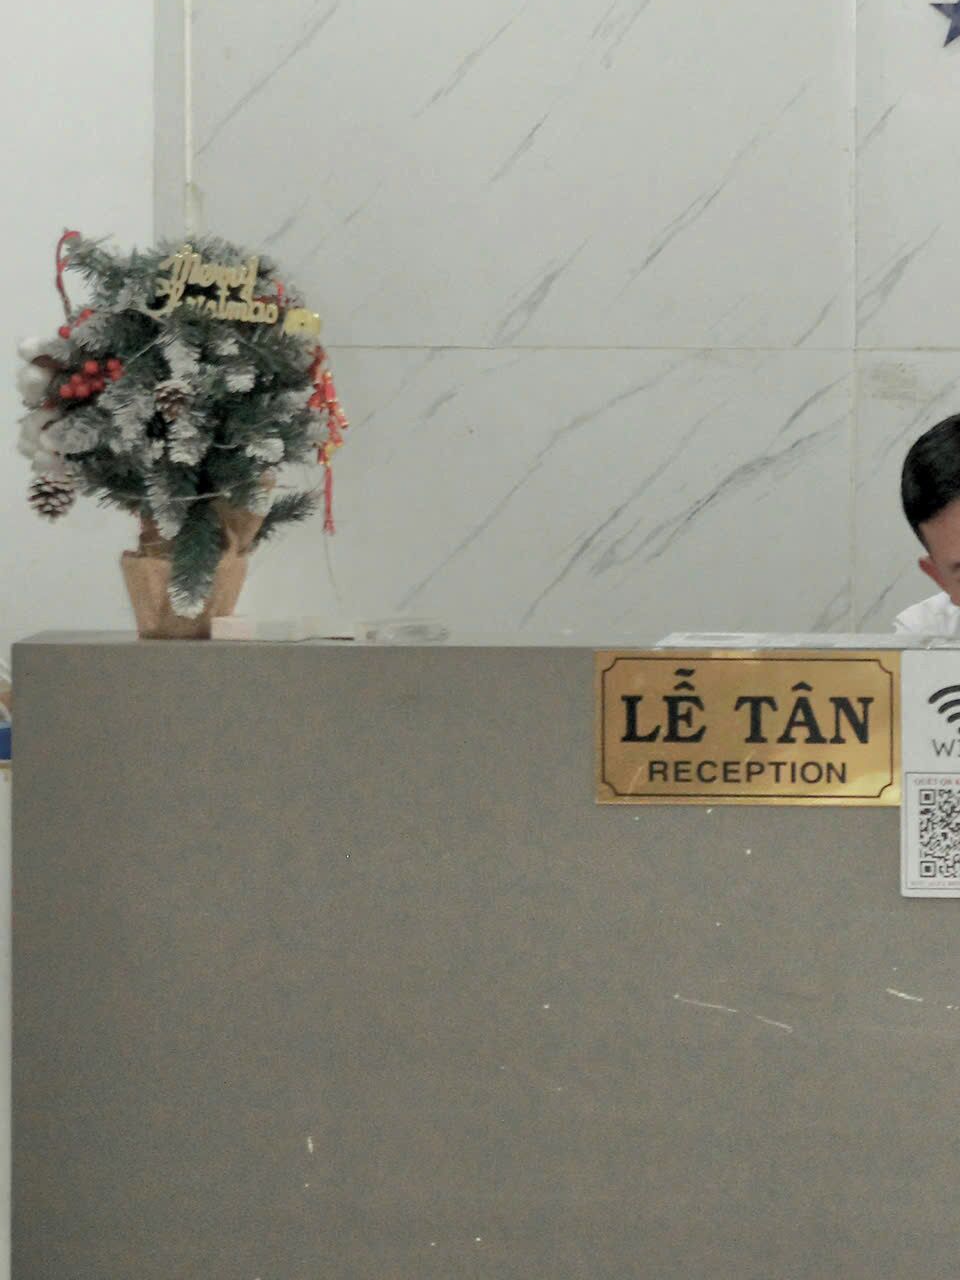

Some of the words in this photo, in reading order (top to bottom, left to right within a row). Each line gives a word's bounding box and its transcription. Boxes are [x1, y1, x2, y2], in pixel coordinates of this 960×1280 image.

[620, 668, 707, 744] LỄ
[733, 681, 875, 745] TÂN
[648, 759, 848, 784] RECEPTION
